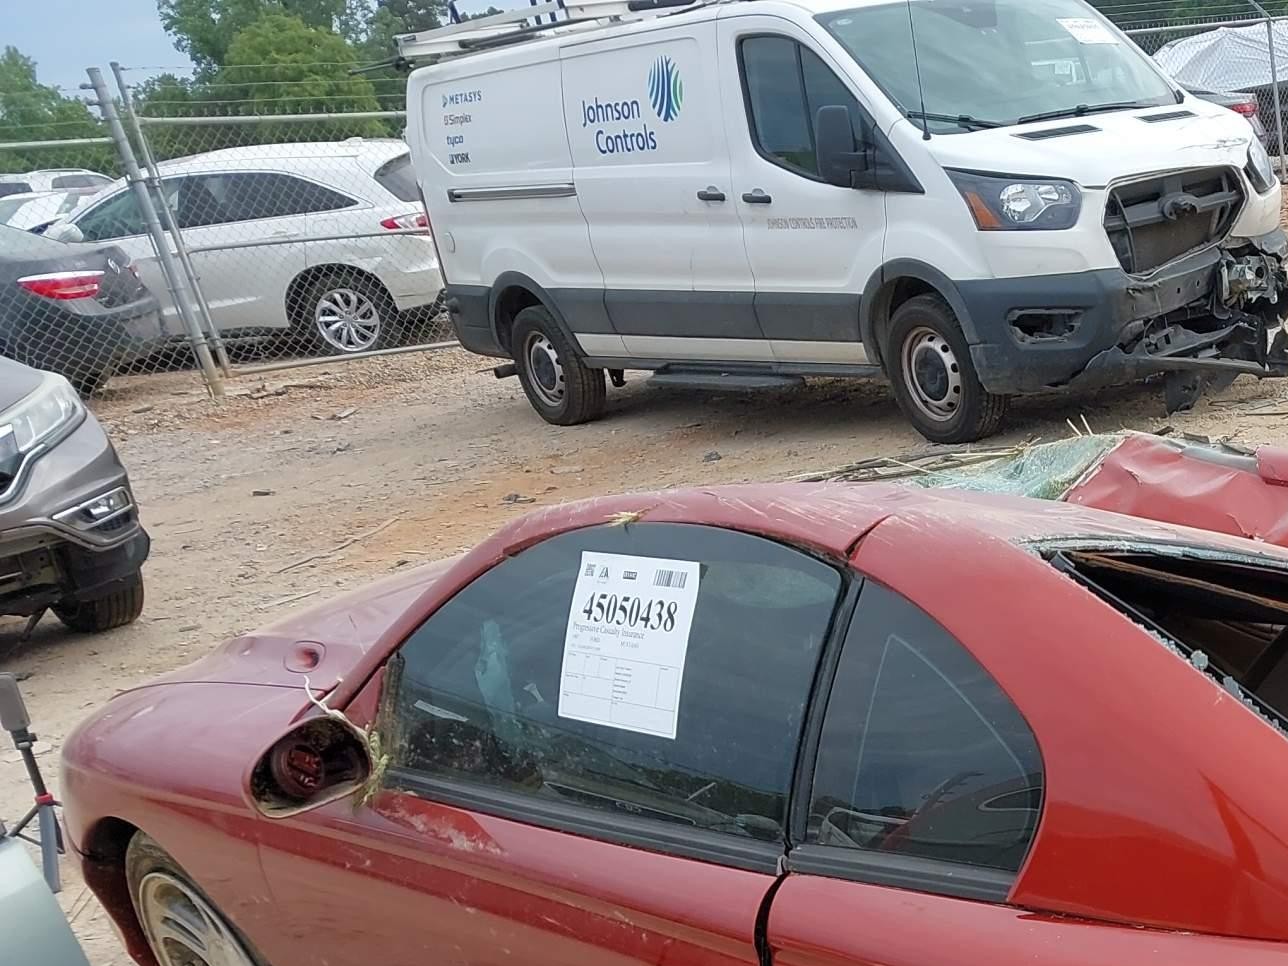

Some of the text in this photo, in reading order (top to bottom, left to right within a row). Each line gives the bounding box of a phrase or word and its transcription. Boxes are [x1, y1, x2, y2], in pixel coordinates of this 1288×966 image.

[449, 90, 482, 105] METASYS
[582, 96, 641, 128] Johnson
[446, 135, 464, 147] tyco
[595, 123, 657, 154] Controls
[453, 152, 471, 164] YORK
[583, 592, 678, 632] 45050438
